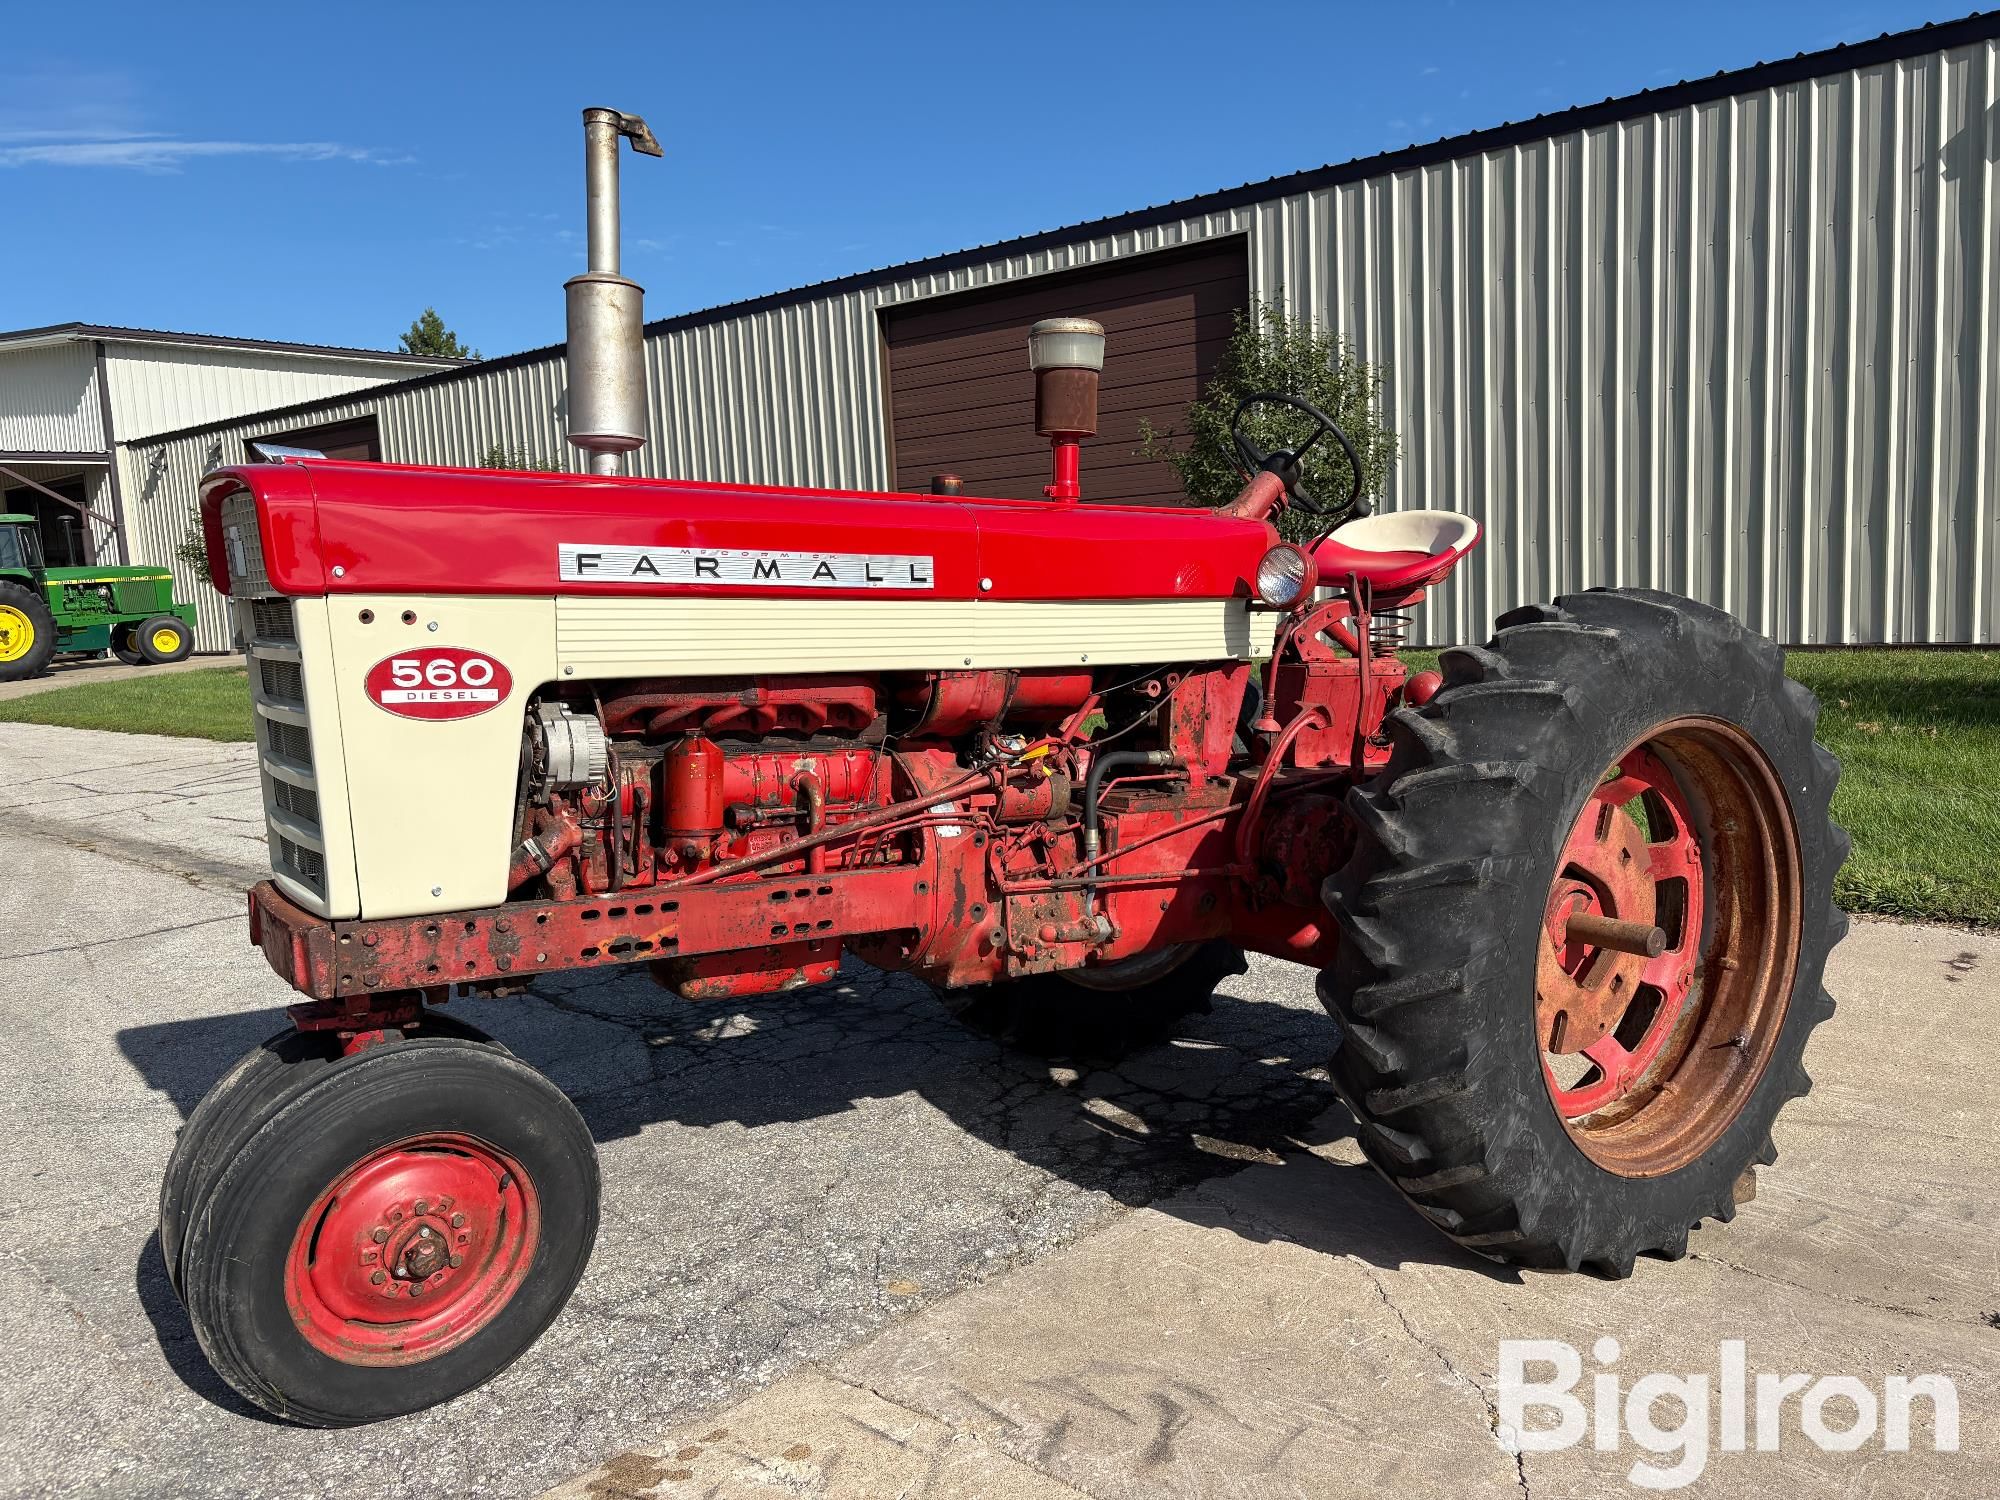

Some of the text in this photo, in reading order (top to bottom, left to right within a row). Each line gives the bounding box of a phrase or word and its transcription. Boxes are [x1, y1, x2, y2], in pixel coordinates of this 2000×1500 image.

[575, 553, 928, 582] FARMALL
[391, 658, 494, 688] 560
[407, 691, 478, 700] DIESEL
